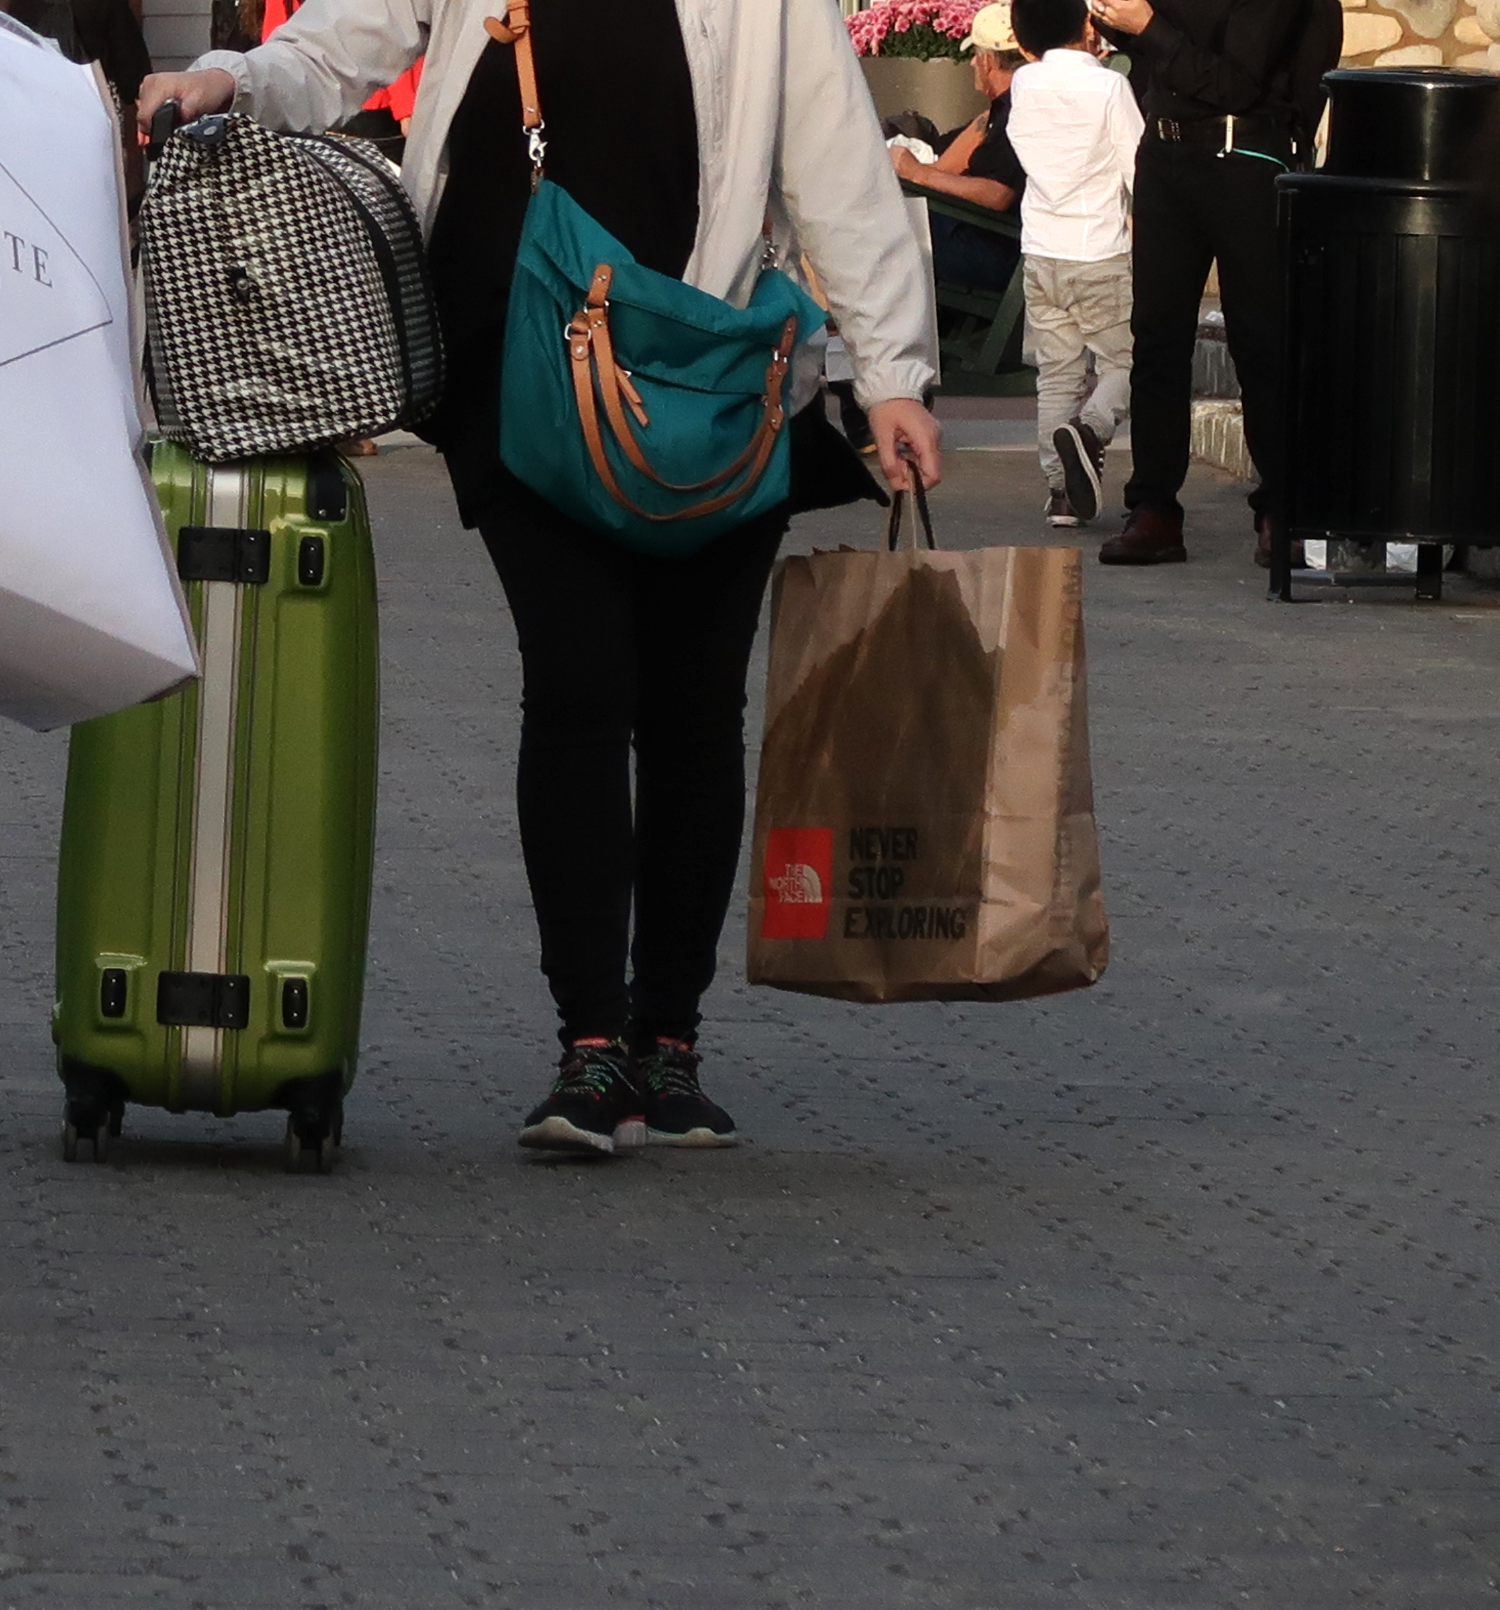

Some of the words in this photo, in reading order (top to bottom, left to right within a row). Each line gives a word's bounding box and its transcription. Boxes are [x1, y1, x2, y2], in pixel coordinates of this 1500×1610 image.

[851, 828, 918, 860] NEVER
[849, 866, 905, 900] STOP
[843, 906, 967, 939] EXPLORING
